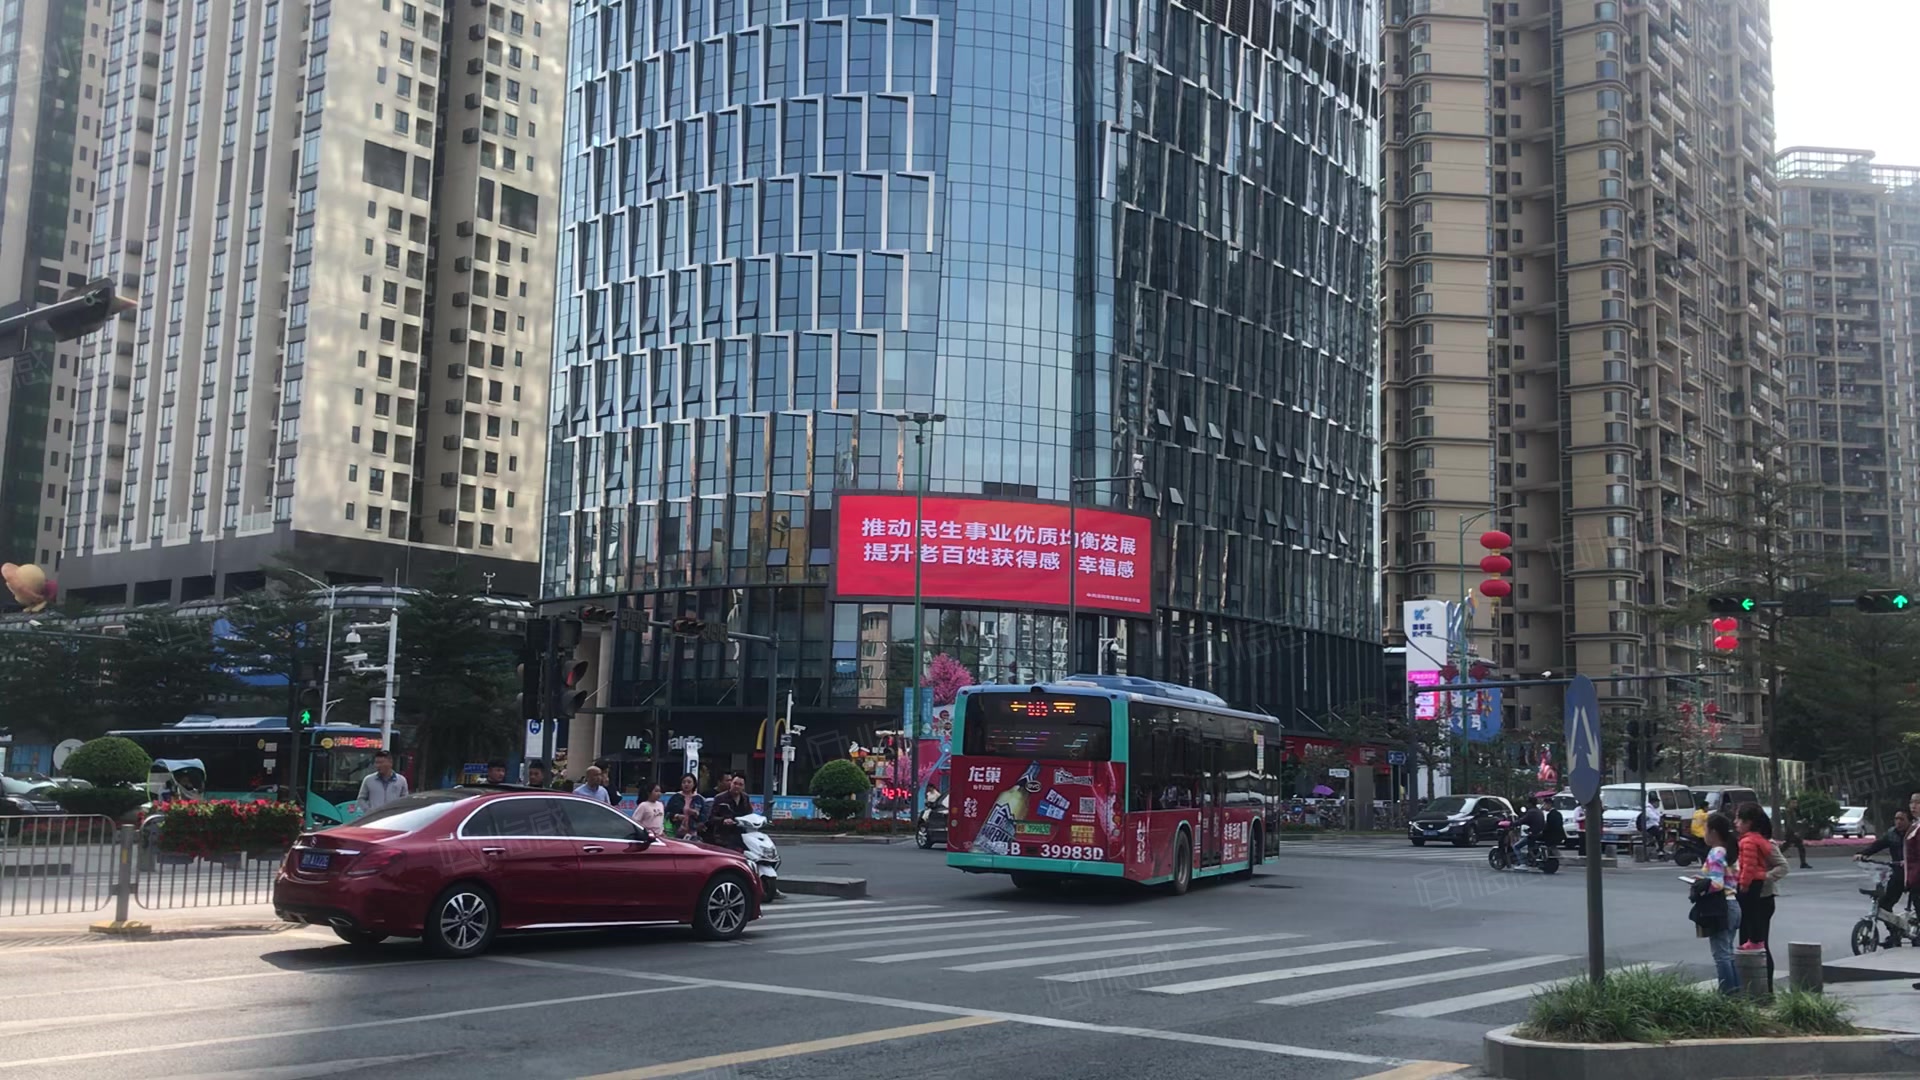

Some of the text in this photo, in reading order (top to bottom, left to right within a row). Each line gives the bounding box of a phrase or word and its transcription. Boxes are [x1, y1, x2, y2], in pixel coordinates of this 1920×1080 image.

[862, 517, 1137, 556] 推动民生事业优质均衡发展
[863, 542, 1135, 579] 提升老百姓获得感 幸福感
[1040, 844, 1105, 861] 39983D
